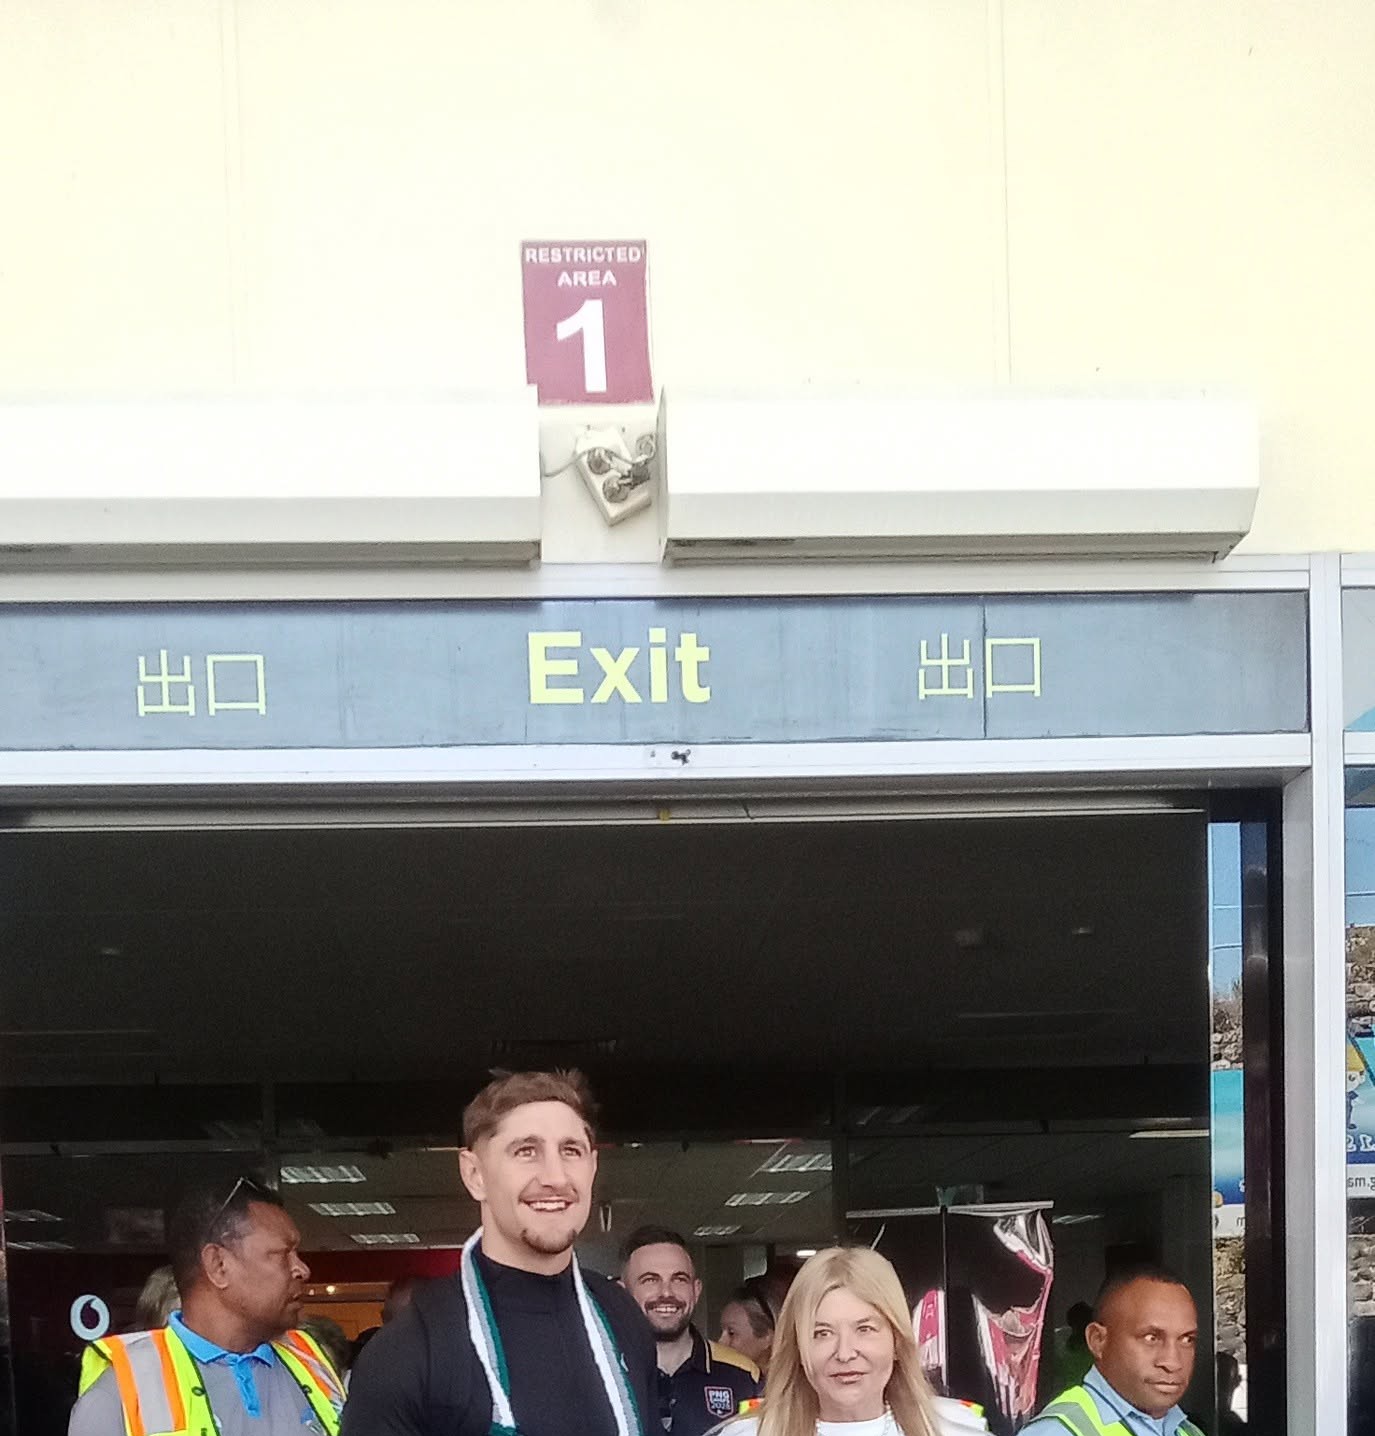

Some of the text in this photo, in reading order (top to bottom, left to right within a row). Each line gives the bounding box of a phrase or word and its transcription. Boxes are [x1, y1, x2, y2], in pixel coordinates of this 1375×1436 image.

[525, 247, 641, 264] RESTRICTED
[557, 270, 617, 287] AREA
[556, 299, 607, 393] 1
[137, 649, 266, 716] 出口
[528, 627, 711, 704] Exit
[919, 633, 1041, 700] 出口
[708, 1390, 730, 1399] PNG
